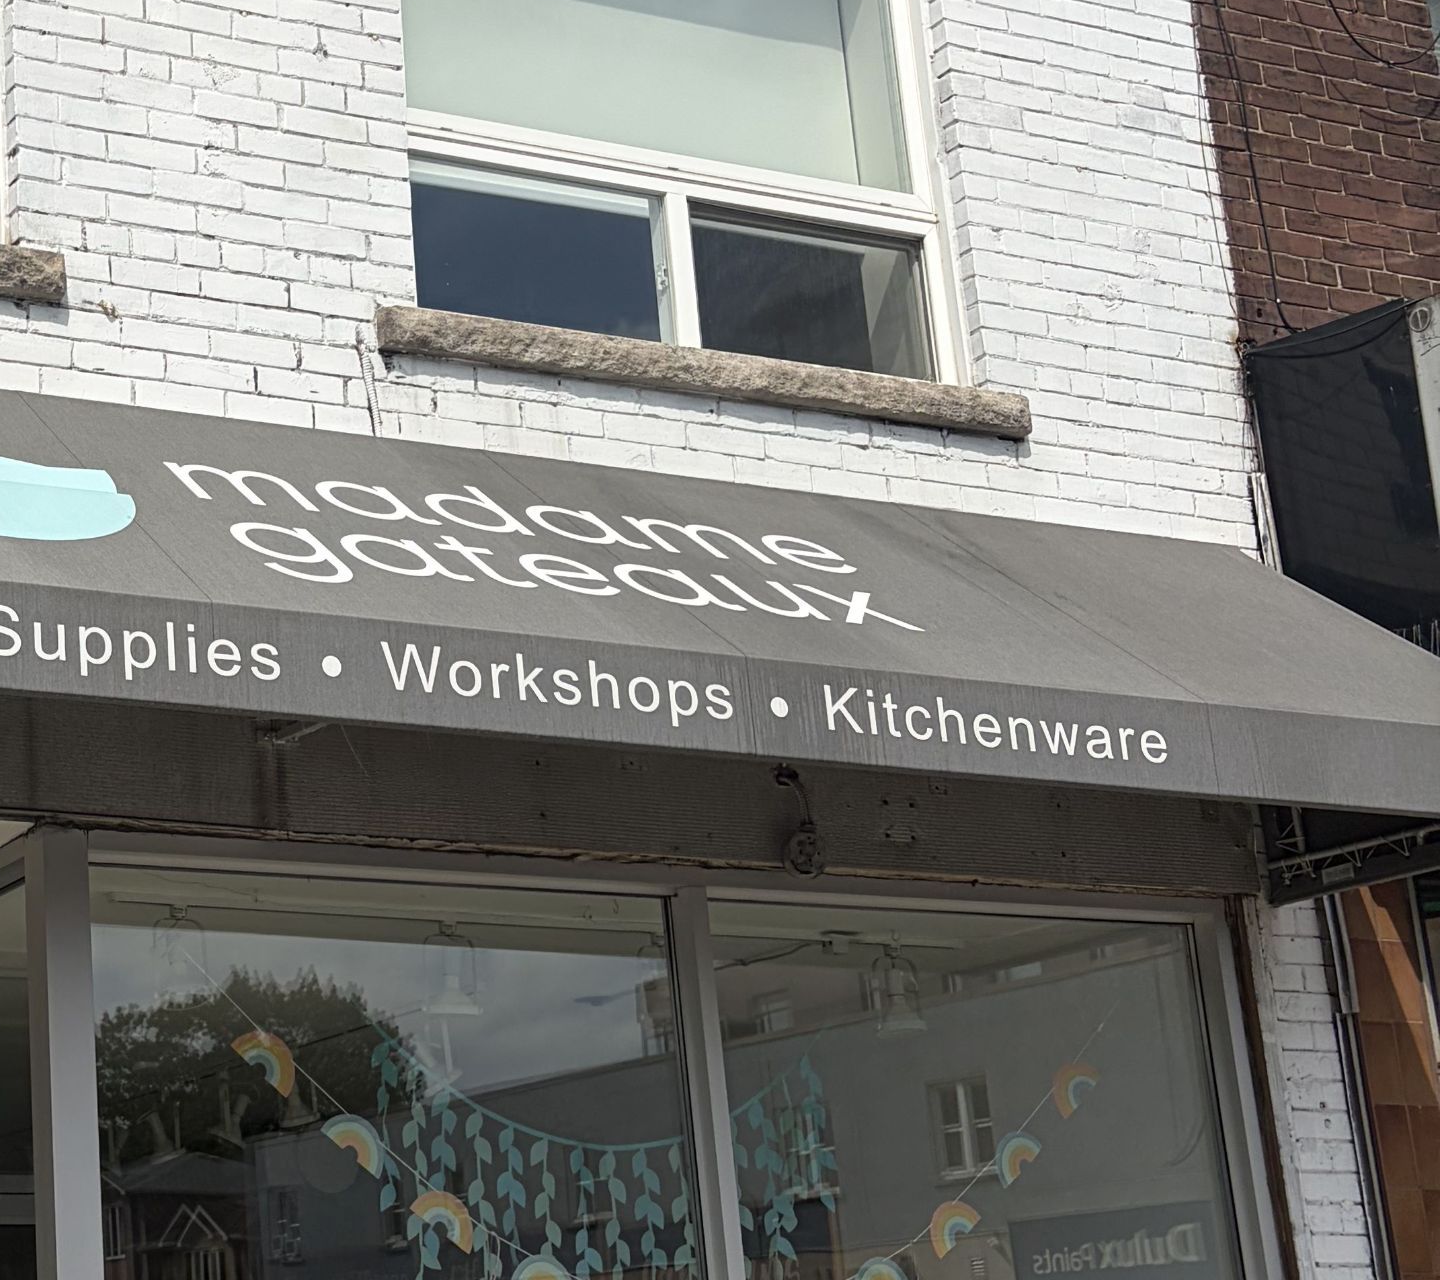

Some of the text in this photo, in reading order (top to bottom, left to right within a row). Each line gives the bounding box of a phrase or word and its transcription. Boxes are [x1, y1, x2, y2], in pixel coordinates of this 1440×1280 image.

[163, 461, 858, 574] madame
[229, 521, 926, 632] gateaux
[380, 640, 734, 728] Workshops
[823, 684, 1168, 764] Kitchenware
